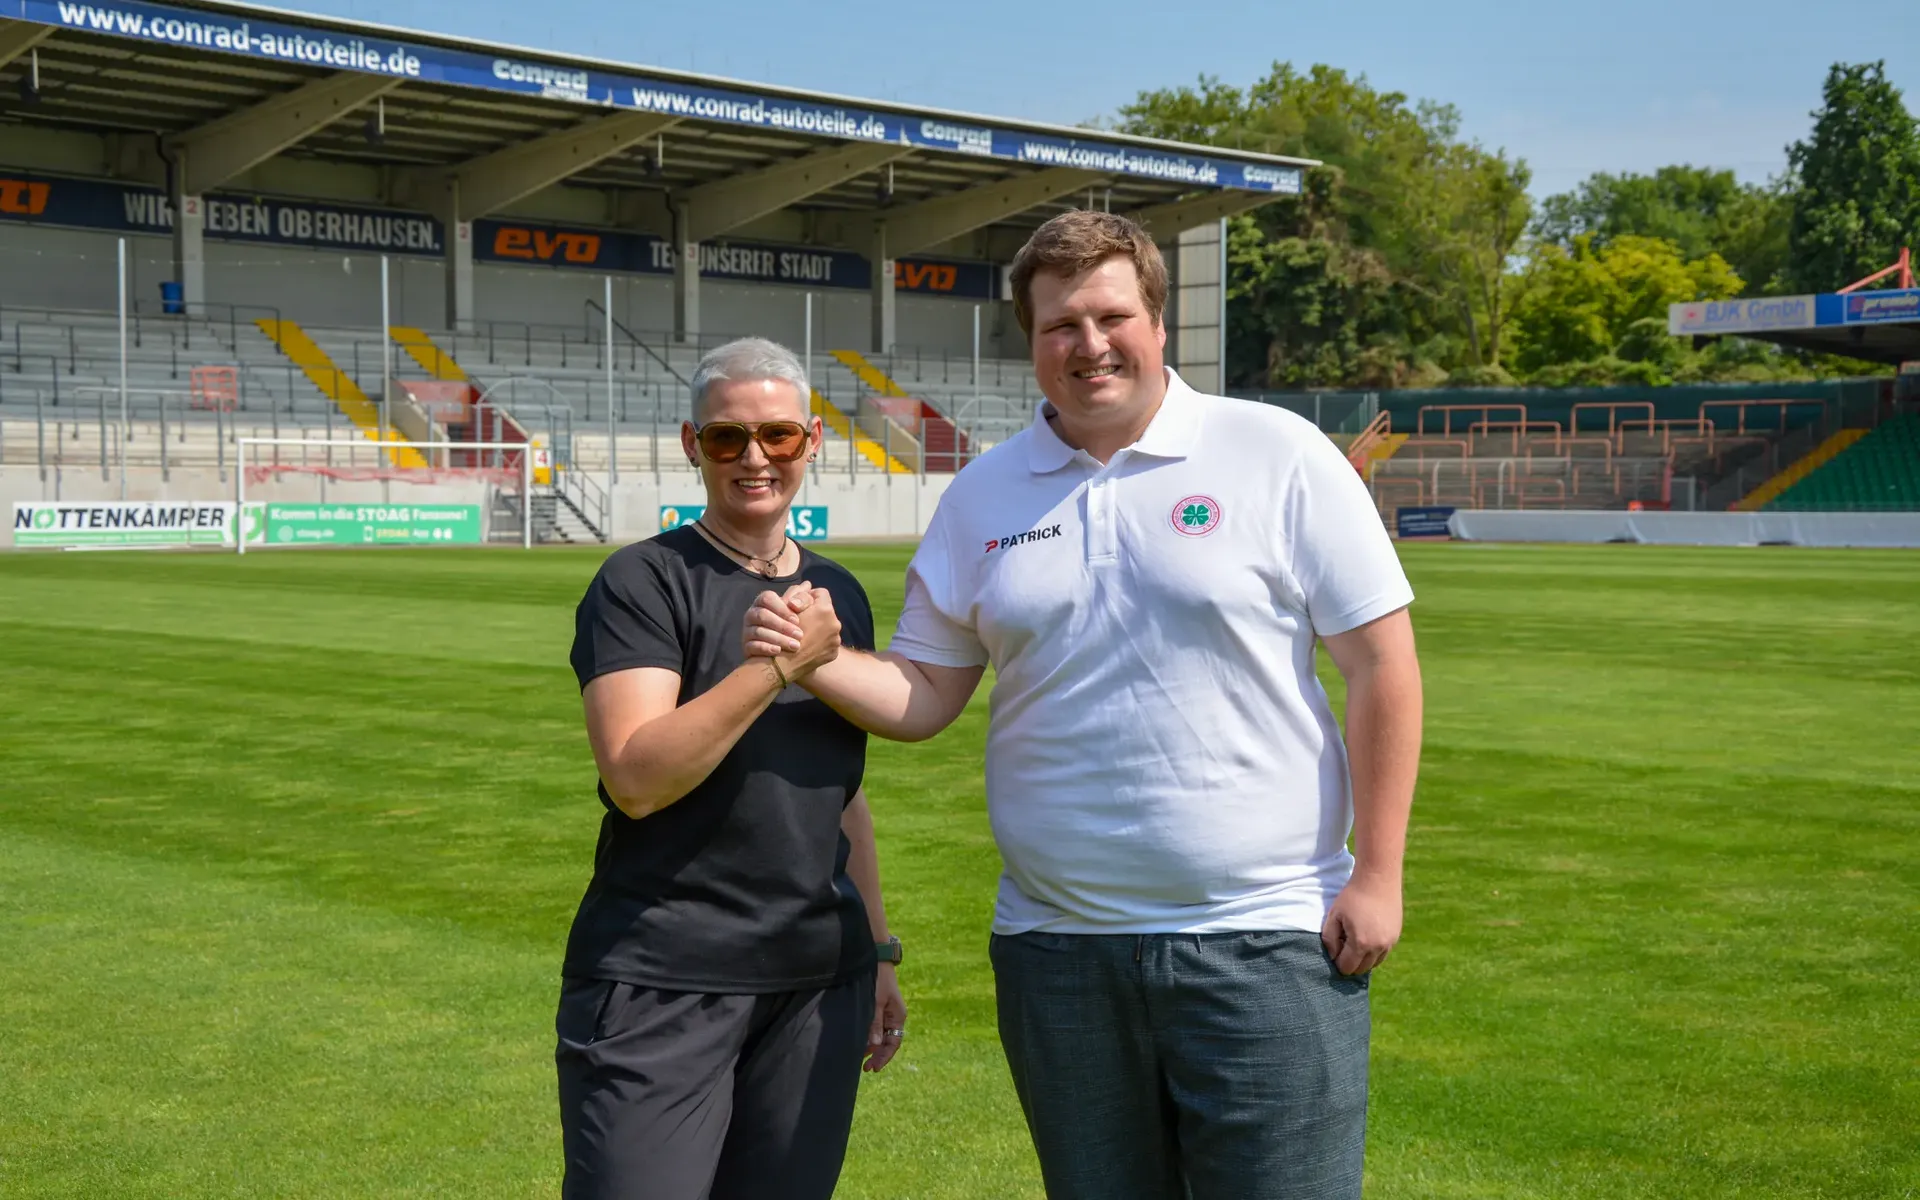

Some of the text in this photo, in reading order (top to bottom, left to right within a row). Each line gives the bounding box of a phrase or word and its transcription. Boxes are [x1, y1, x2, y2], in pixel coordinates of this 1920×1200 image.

[57, 1, 421, 77] www.conrad-autoteile.de
[493, 60, 589, 91] Conrad
[632, 87, 886, 140] www.conrad-autoteile.de
[921, 121, 992, 147] Conrad
[1023, 140, 1218, 183] www.conrad-autoteile.de
[1243, 166, 1299, 186] Conrad
[124, 192, 174, 226] WIR
[278, 204, 440, 250] OBERHAUSEN.
[780, 253, 833, 281] STADT
[357, 508, 410, 521] STOAG
[1001, 524, 1062, 549] PATRICK
